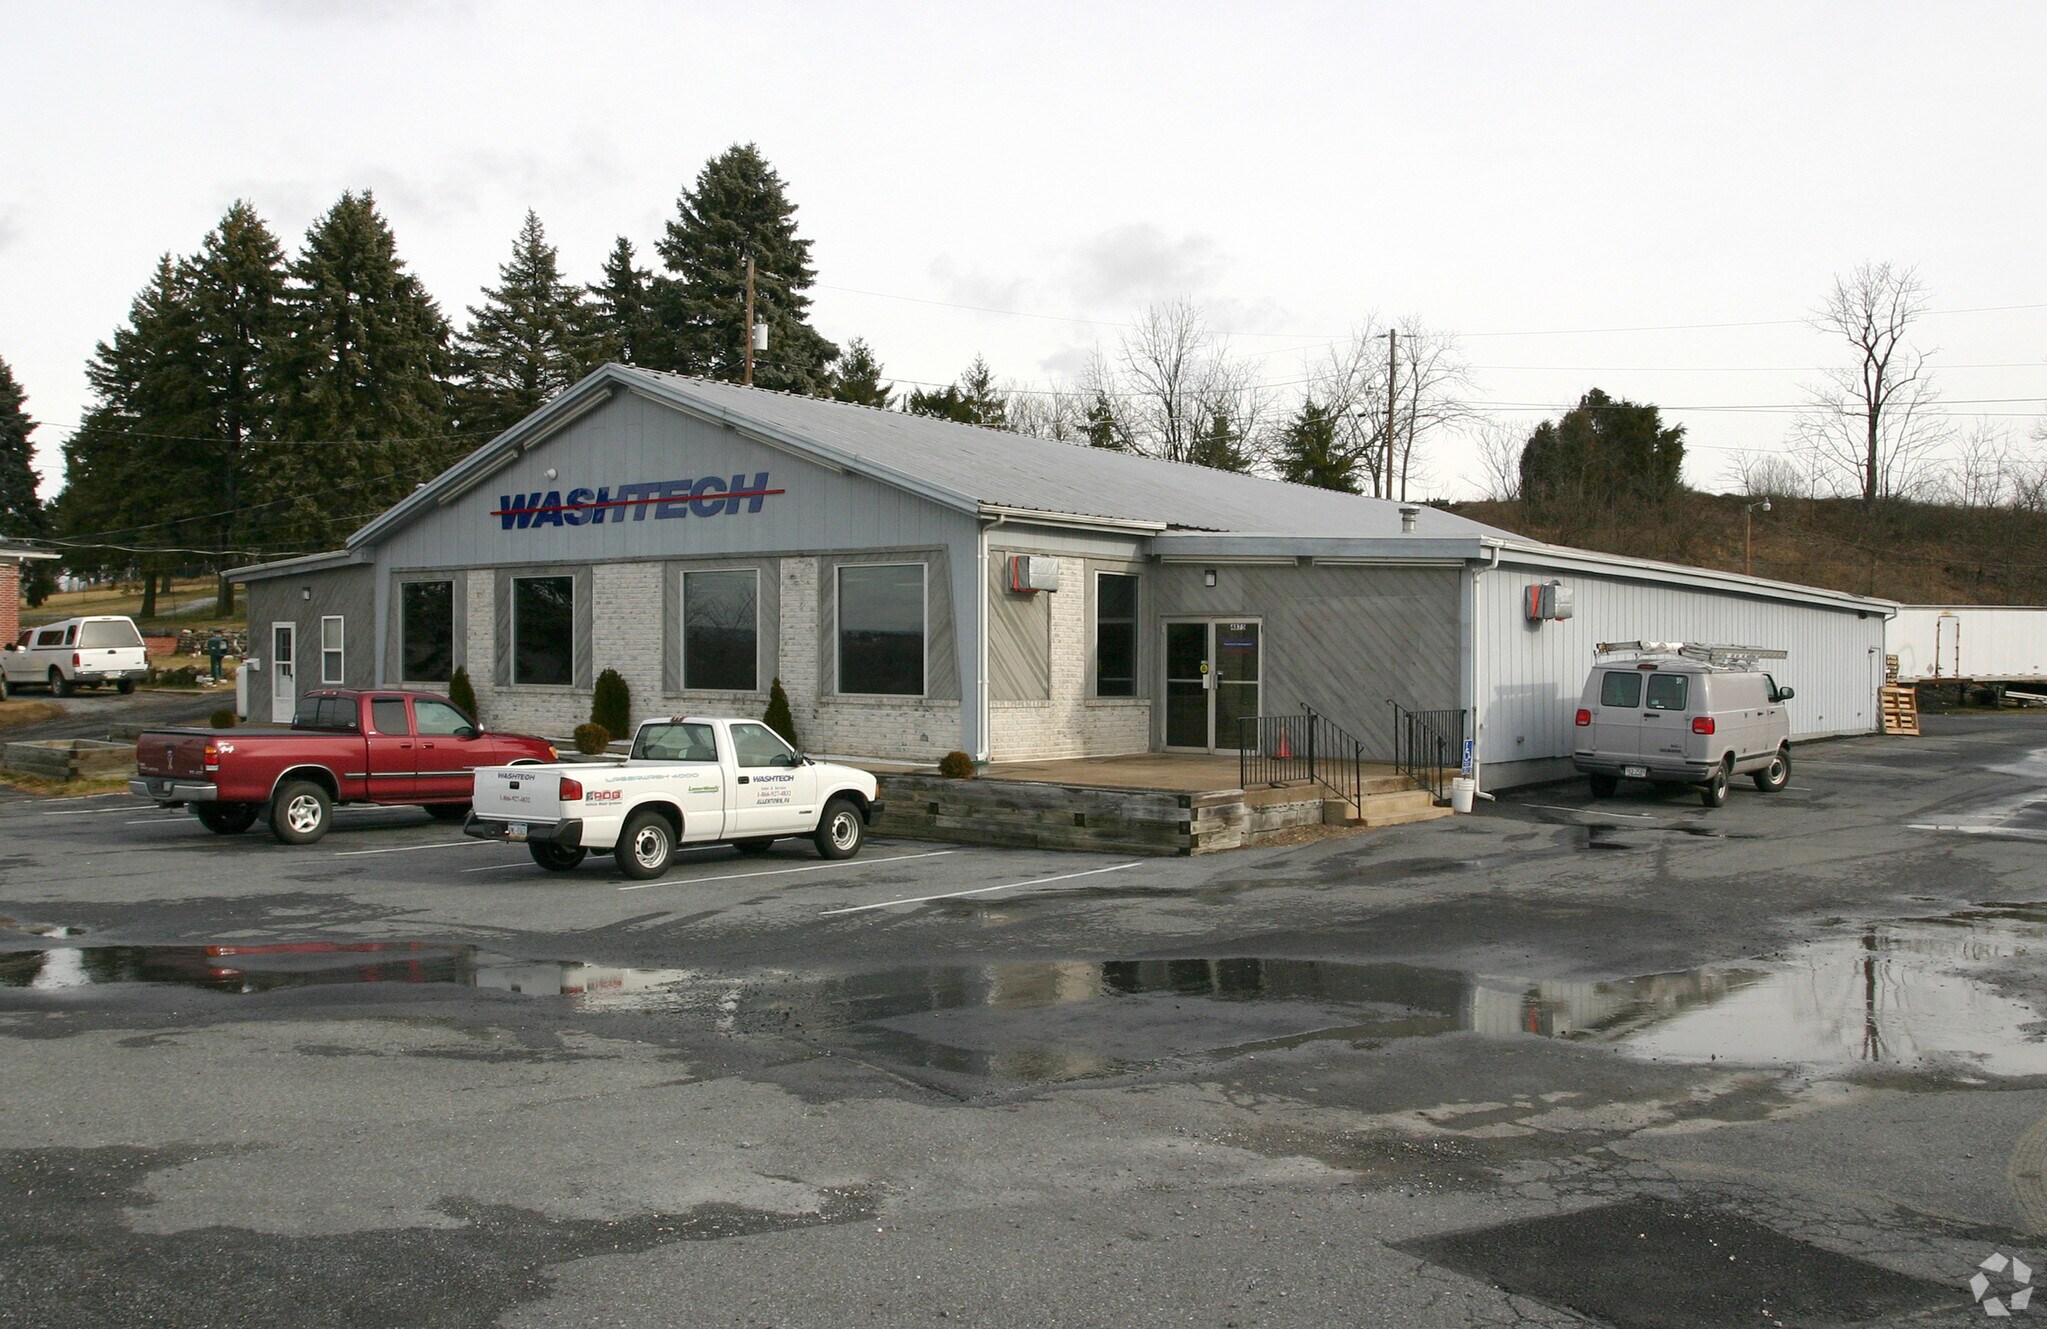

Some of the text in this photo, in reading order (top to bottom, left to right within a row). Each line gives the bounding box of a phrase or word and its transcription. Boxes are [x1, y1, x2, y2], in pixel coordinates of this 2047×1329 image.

[499, 471, 770, 530] WASHTECH
[497, 772, 536, 781] WASHTECH
[753, 774, 795, 782] WASHTECH
